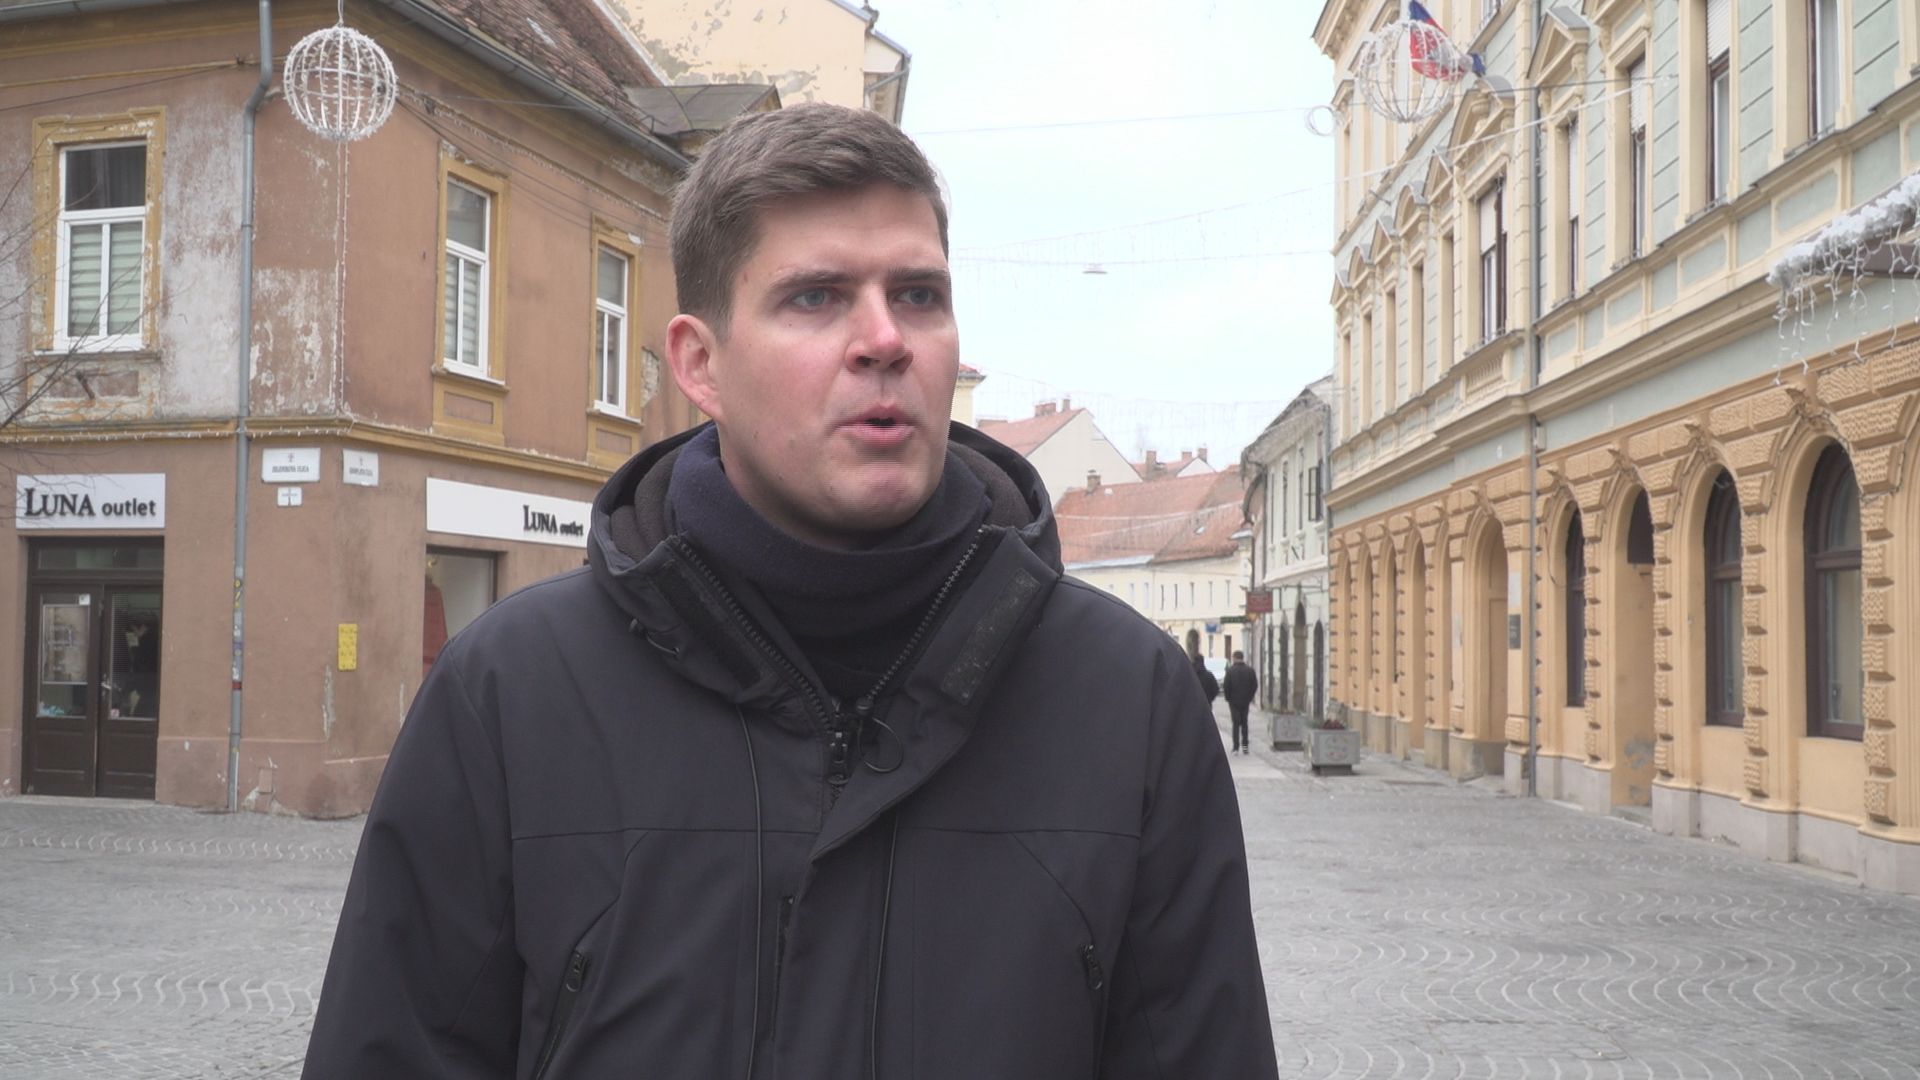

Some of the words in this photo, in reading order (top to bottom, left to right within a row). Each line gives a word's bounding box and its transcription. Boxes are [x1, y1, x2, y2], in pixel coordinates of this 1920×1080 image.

[24, 487, 95, 517] LUNA
[102, 498, 156, 516] outlet
[523, 504, 558, 534] LUNA
[560, 520, 584, 536] outlet
